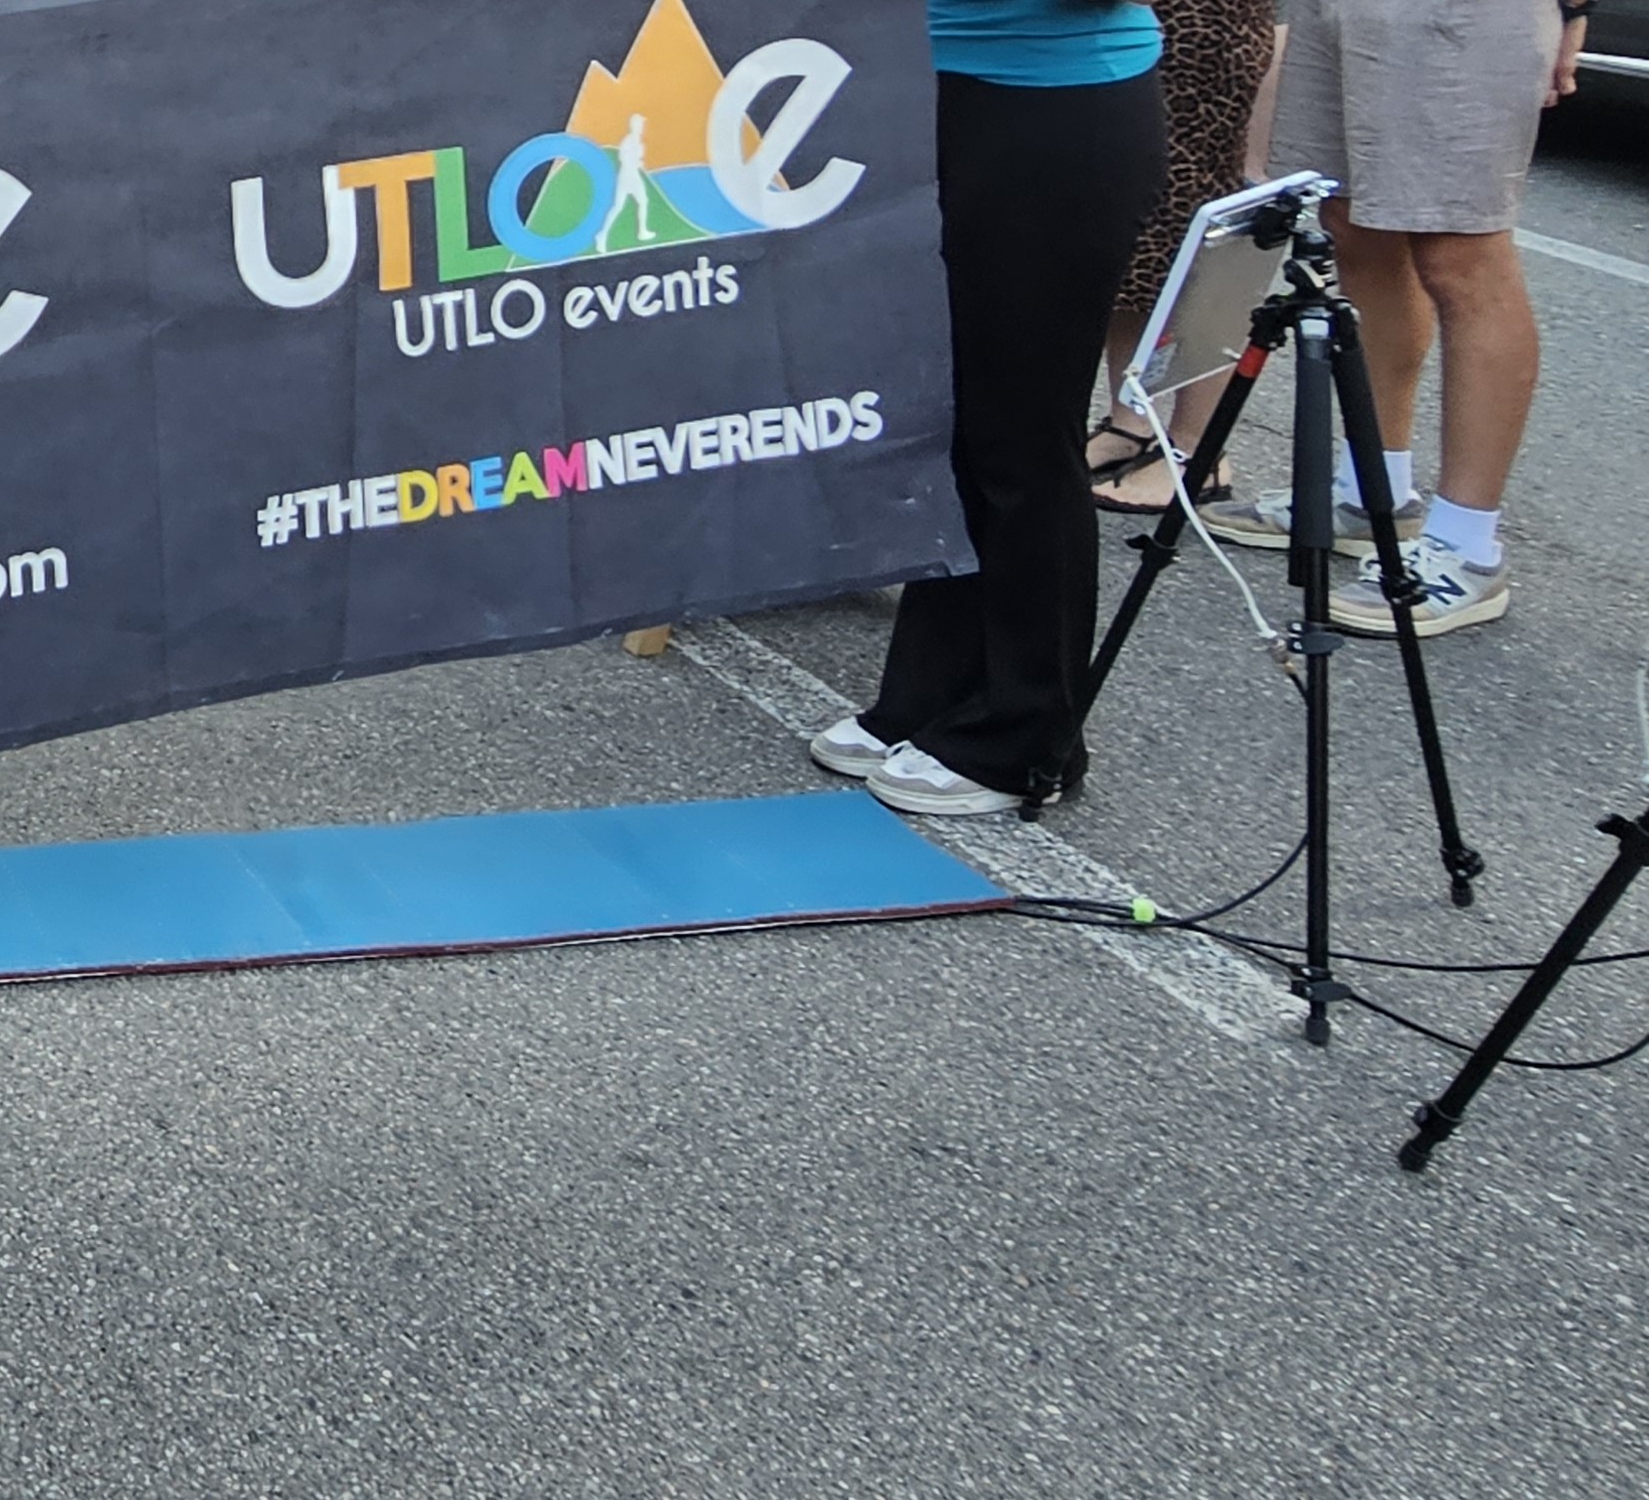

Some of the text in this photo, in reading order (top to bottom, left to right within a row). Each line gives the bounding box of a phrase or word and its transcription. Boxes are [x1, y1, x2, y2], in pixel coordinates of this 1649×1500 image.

[392, 255, 740, 357] UTLO events
[256, 390, 885, 548] #THEDREAMNEVERENDS
